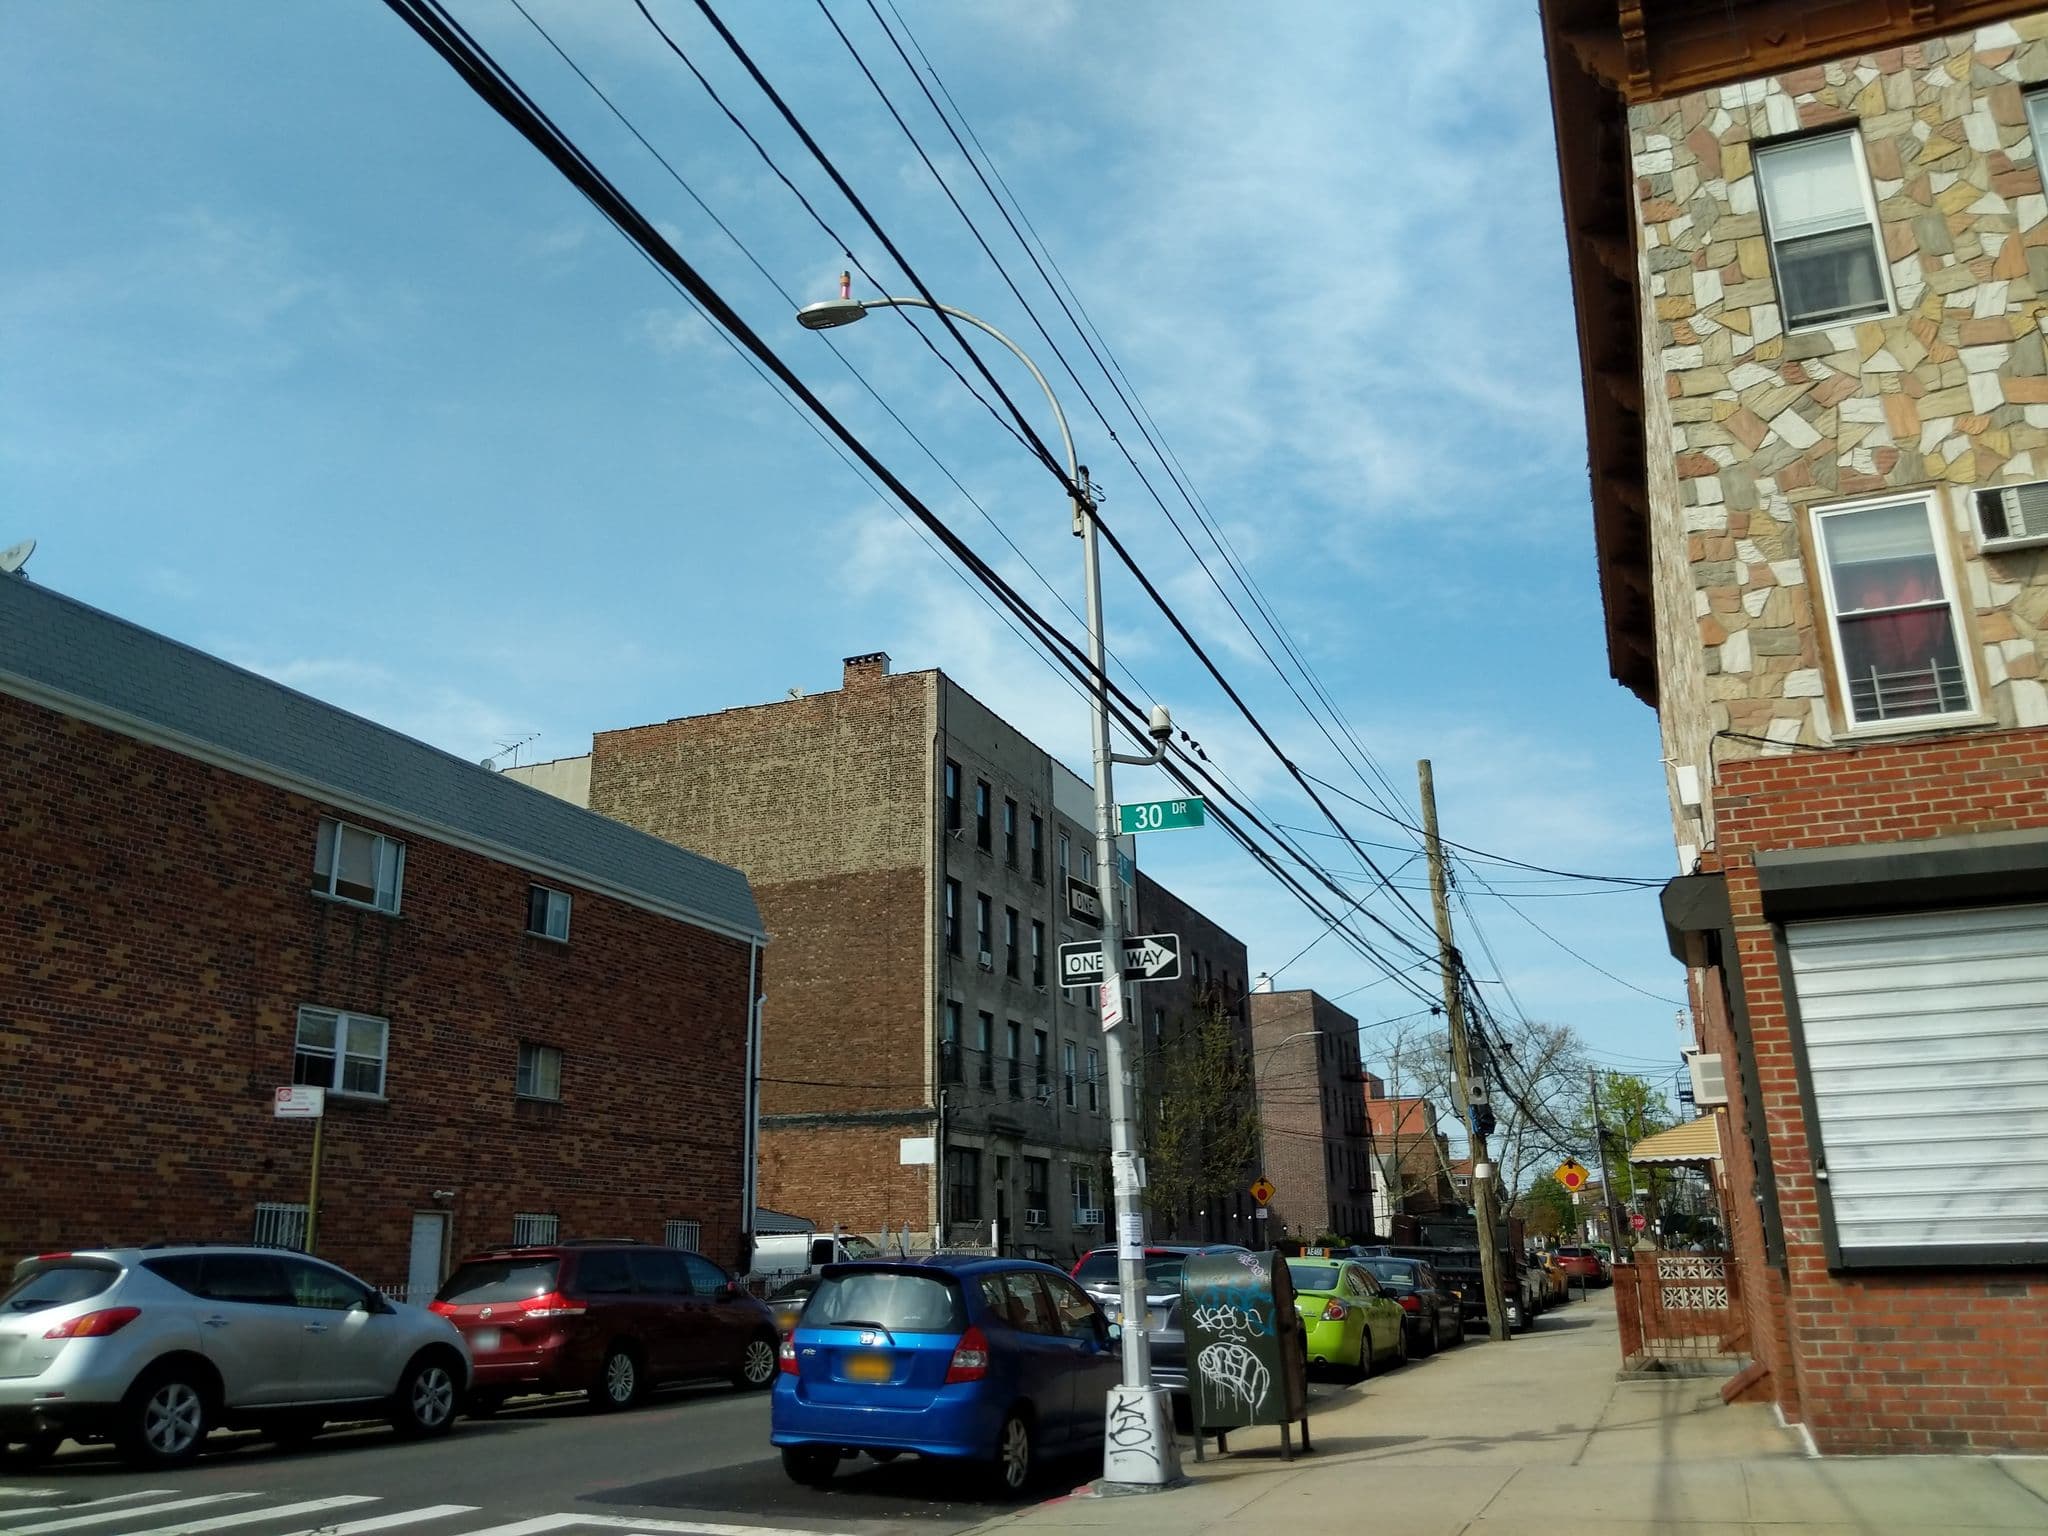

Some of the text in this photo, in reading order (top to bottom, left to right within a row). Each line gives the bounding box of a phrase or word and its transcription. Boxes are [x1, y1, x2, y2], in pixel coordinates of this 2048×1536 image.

[1135, 802, 1187, 829] 30 DR
[1076, 893, 1094, 914] ONE
[1070, 949, 1164, 973] ONE WAY
